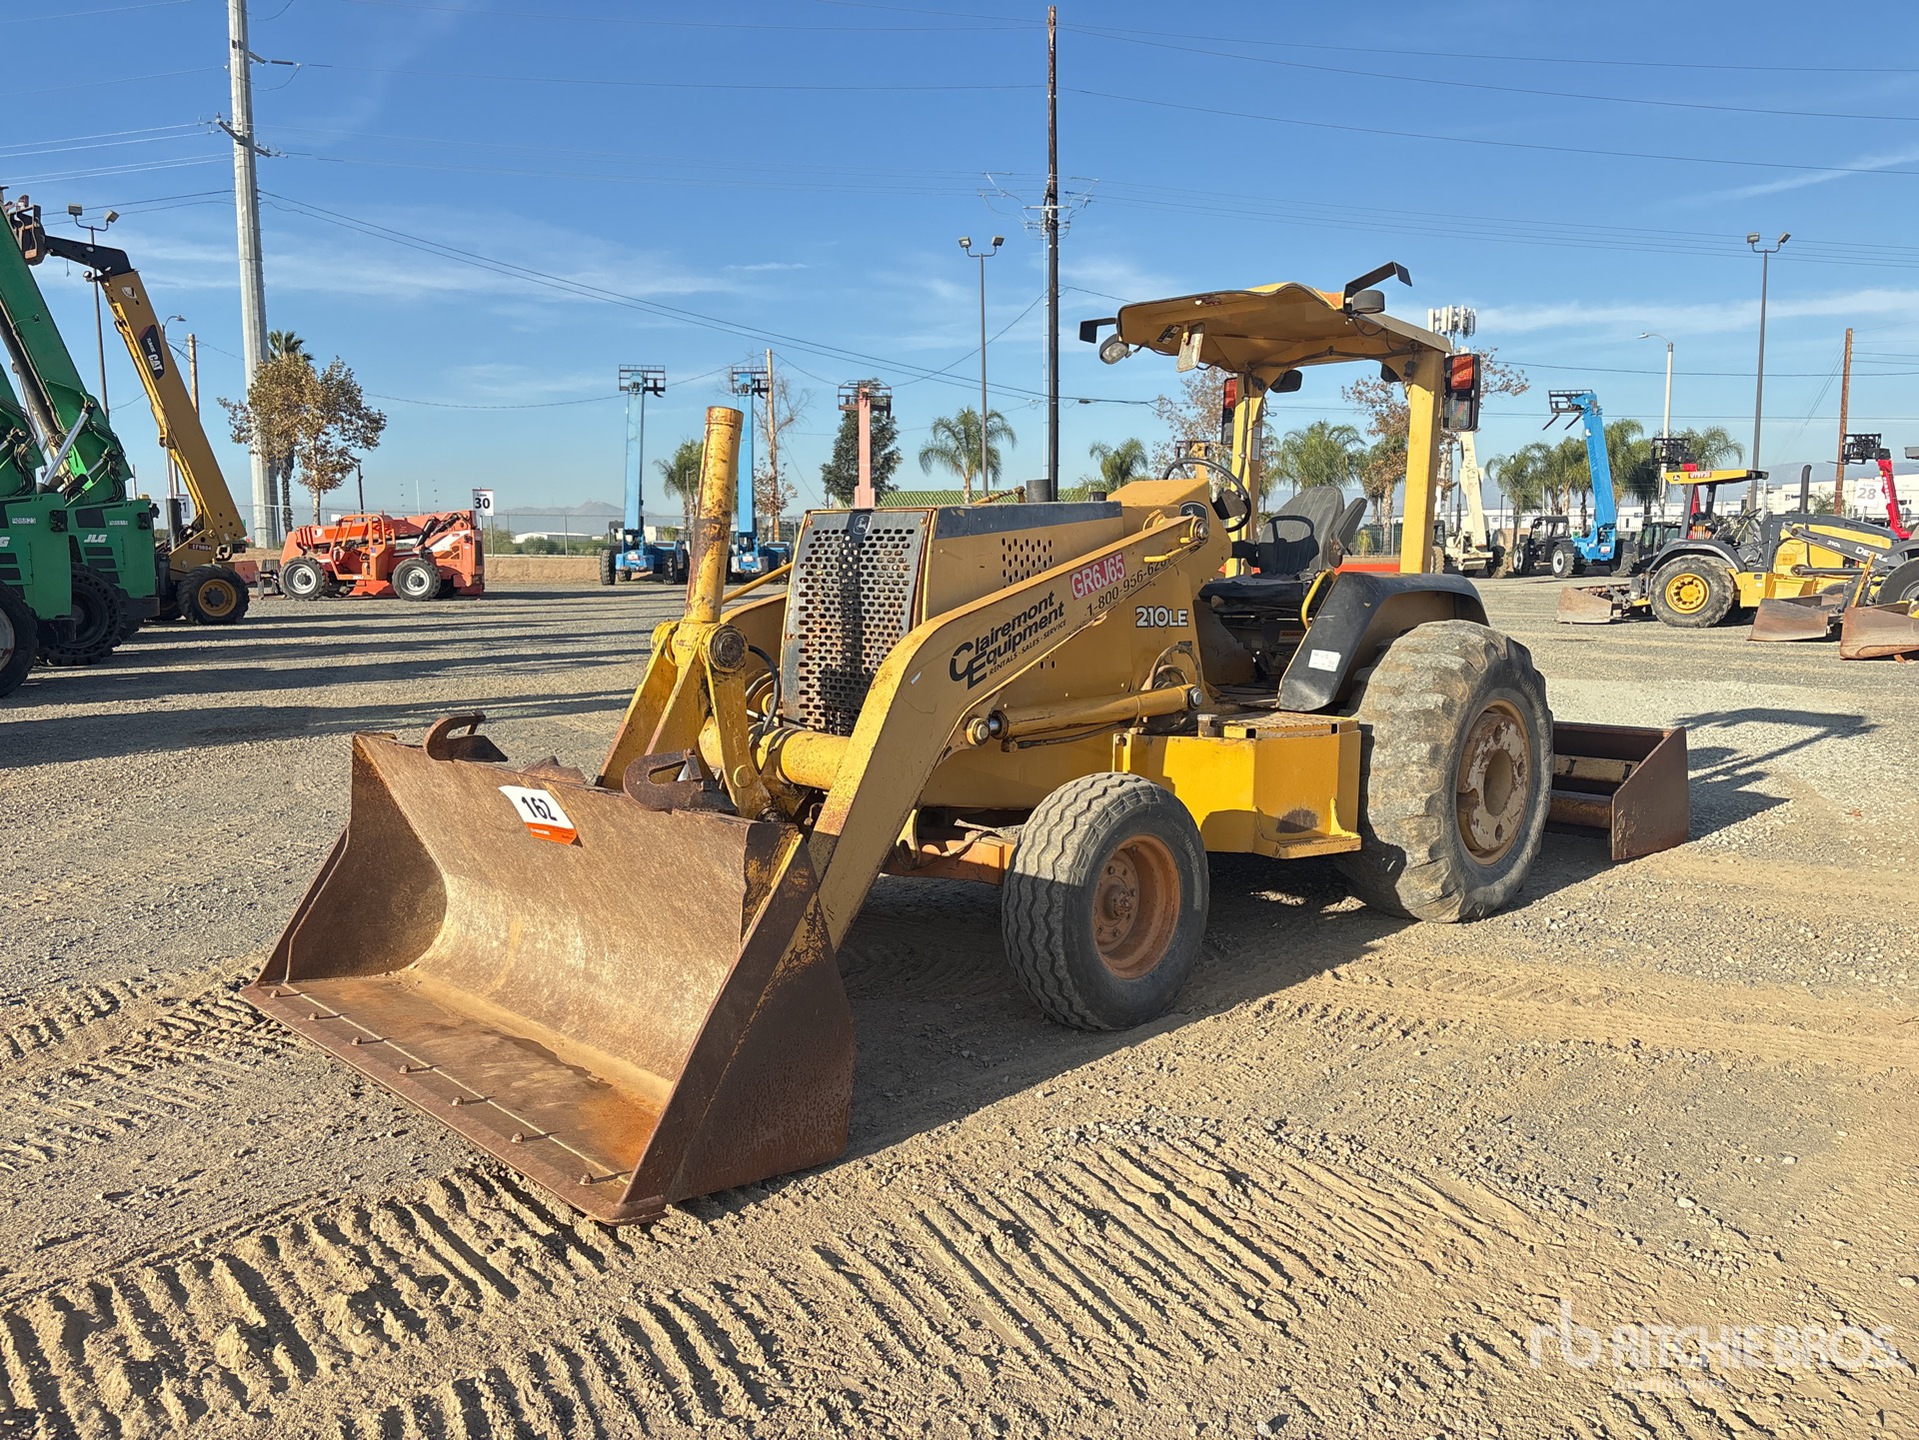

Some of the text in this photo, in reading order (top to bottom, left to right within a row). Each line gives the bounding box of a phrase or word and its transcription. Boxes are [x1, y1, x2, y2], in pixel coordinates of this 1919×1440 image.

[148, 354, 164, 371] CAT
[474, 497, 490, 509] 30
[1857, 488, 1876, 500] 28
[84, 534, 107, 543] JLG
[1071, 554, 1125, 599] GR6J65
[1135, 605, 1188, 628] 210LE
[949, 590, 1055, 682] Clairemont
[967, 601, 1065, 690] Equipment
[989, 619, 1067, 676] RENTALS SALES SERVICE
[521, 796, 558, 822] 162
